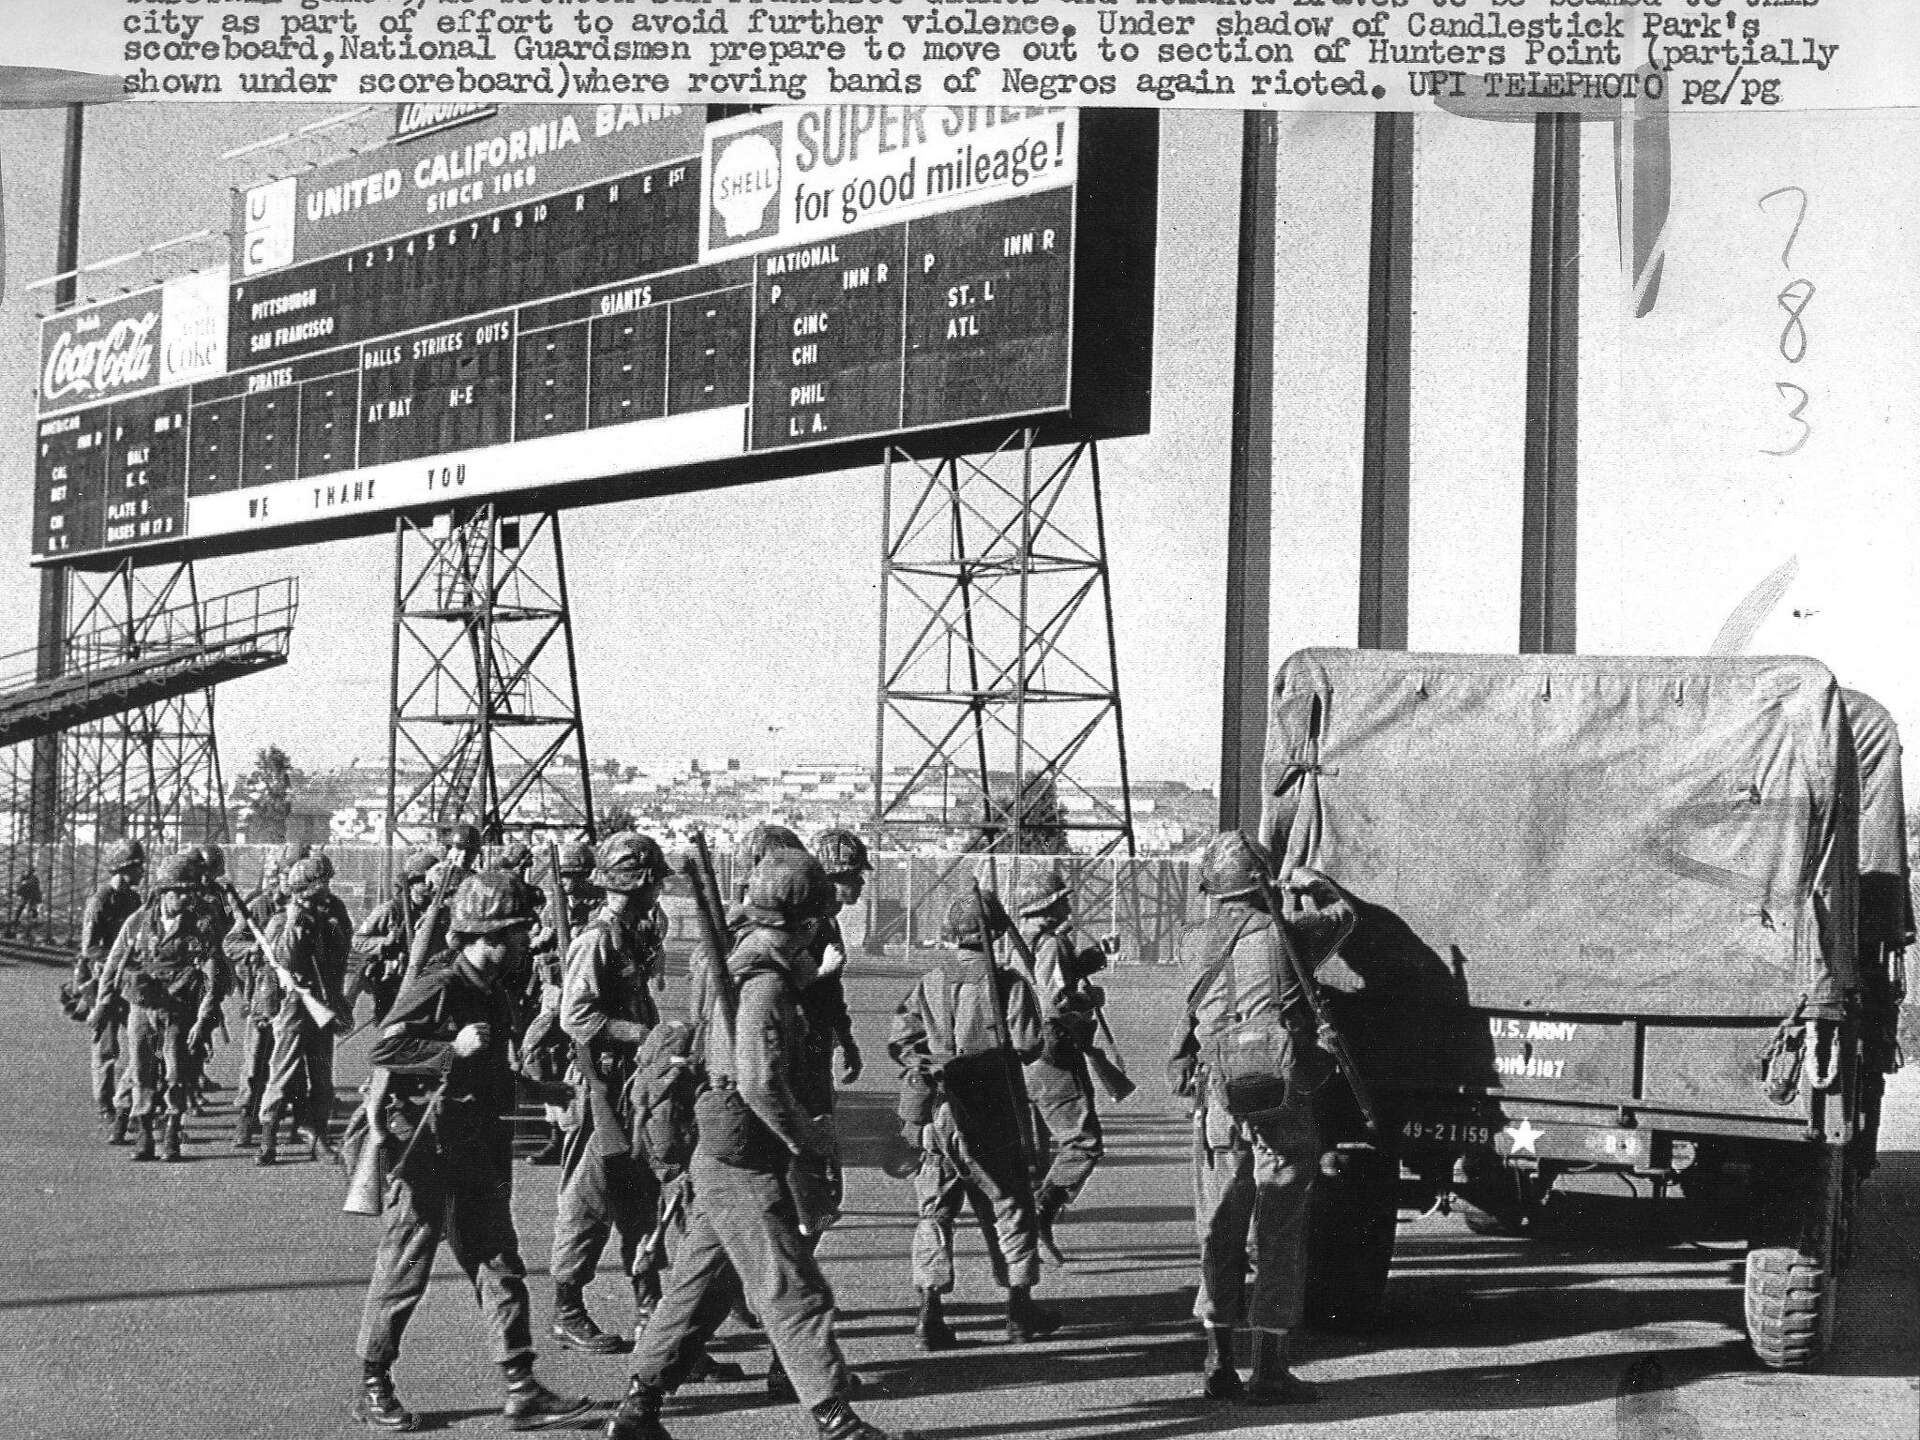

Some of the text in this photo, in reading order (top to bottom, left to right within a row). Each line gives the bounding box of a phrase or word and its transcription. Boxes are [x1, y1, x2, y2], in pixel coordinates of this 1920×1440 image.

[797, 103, 927, 172] SUPER
[307, 168, 402, 221] UNITED
[414, 115, 580, 189] CALIFORNIA
[719, 168, 773, 200] SHELL
[795, 121, 1065, 223] for good mileage!
[251, 195, 267, 222] U
[427, 182, 484, 214] SINCE
[366, 251, 375, 268] 2
[386, 246, 394, 262] 3
[406, 240, 414, 256] 4
[427, 234, 435, 251] 5
[448, 229, 456, 245] 6
[471, 223, 479, 239] 7
[534, 204, 548, 222] 10
[576, 195, 585, 211] R
[609, 185, 619, 202] H
[643, 175, 652, 193] E
[766, 243, 840, 276] NATIONAL
[923, 228, 1056, 273] P INN R
[771, 262, 889, 304] P INN R
[984, 280, 995, 302] L
[252, 288, 317, 321] PITTSBURGH
[600, 285, 652, 316] GIANTS
[251, 317, 334, 353] SAN FRANCISCO
[793, 312, 829, 337] CINC
[946, 315, 980, 340] ATL
[364, 321, 510, 371] BALLS STRIKES OUTS
[791, 344, 818, 366] CHI
[248, 367, 294, 392] PIRATES
[790, 383, 826, 407] PHIL
[368, 397, 413, 423] AT BAT
[427, 463, 467, 491] YOU
[1489, 1017, 1578, 1042] U.S. ARMY
